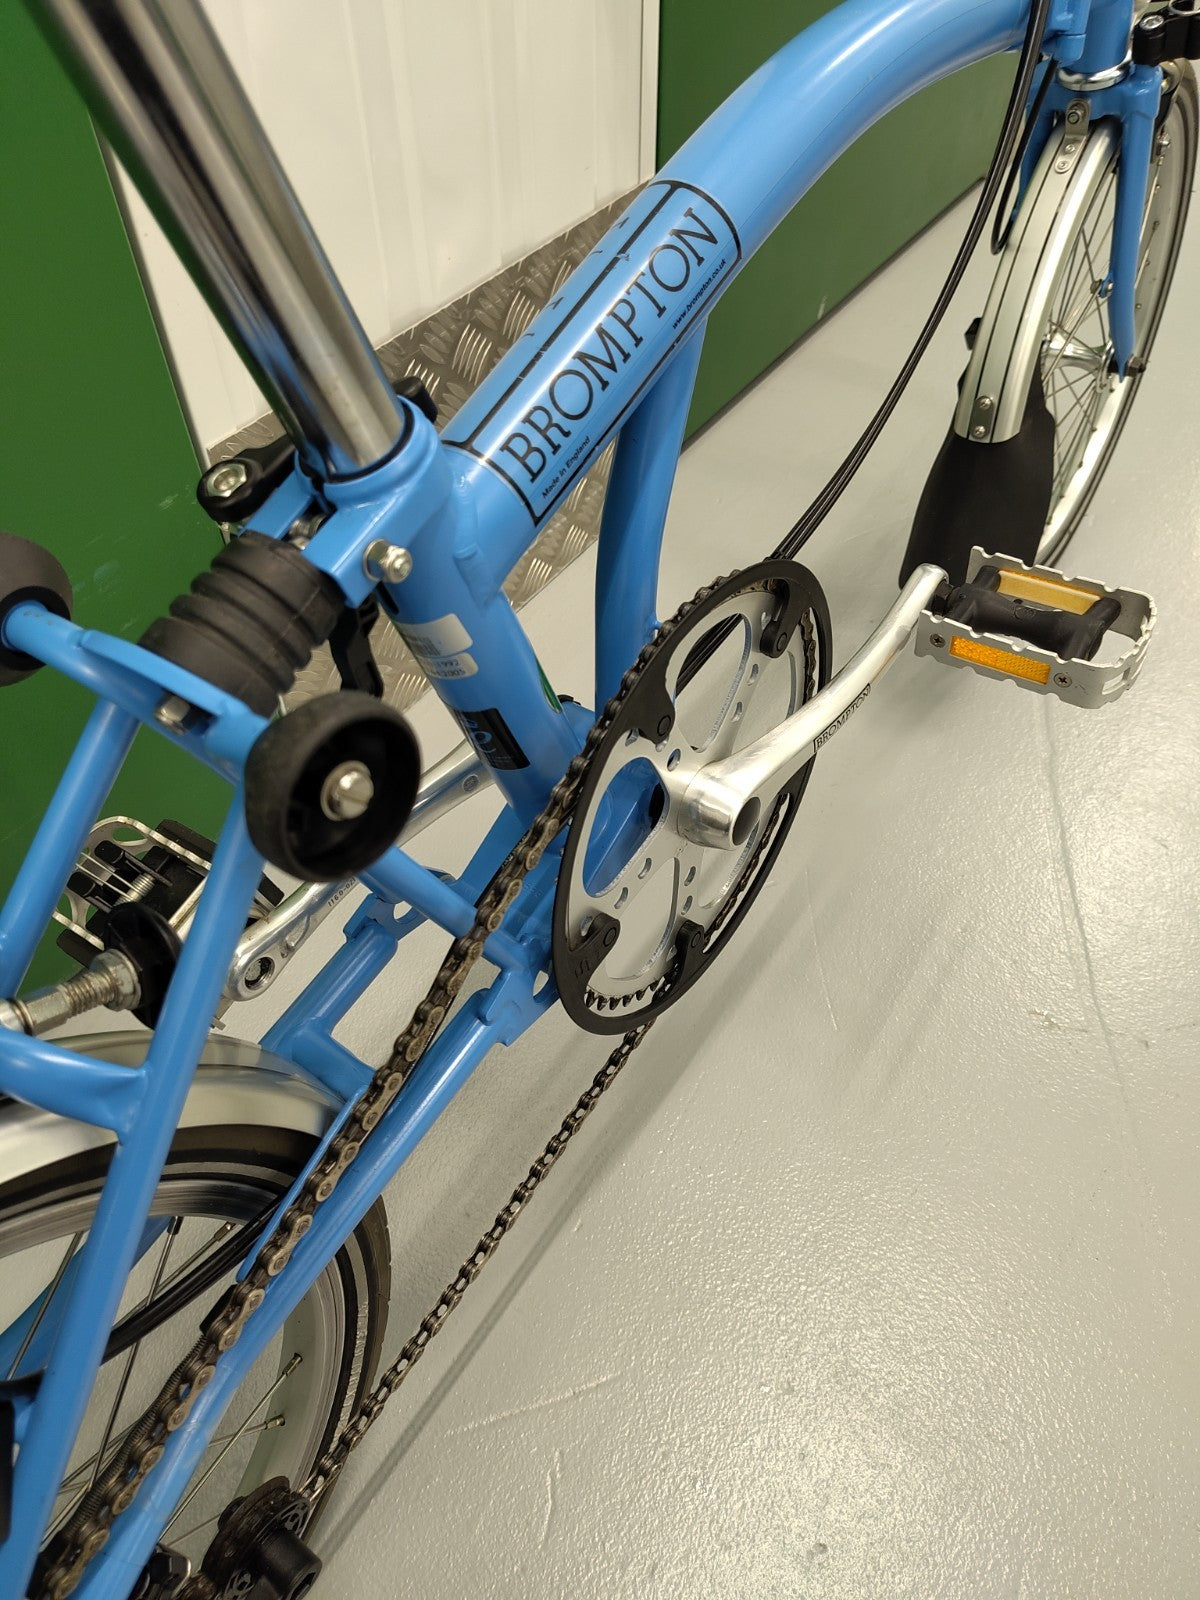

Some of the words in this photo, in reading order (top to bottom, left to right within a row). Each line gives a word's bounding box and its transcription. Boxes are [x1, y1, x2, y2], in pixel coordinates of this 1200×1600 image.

[673, 258, 726, 330] www.brompton.co.uk
[500, 207, 719, 483] BROMPTON
[541, 477, 560, 499] Made
[559, 468, 567, 477] in
[565, 435, 590, 468] England
[816, 684, 871, 748] BROMPTON
